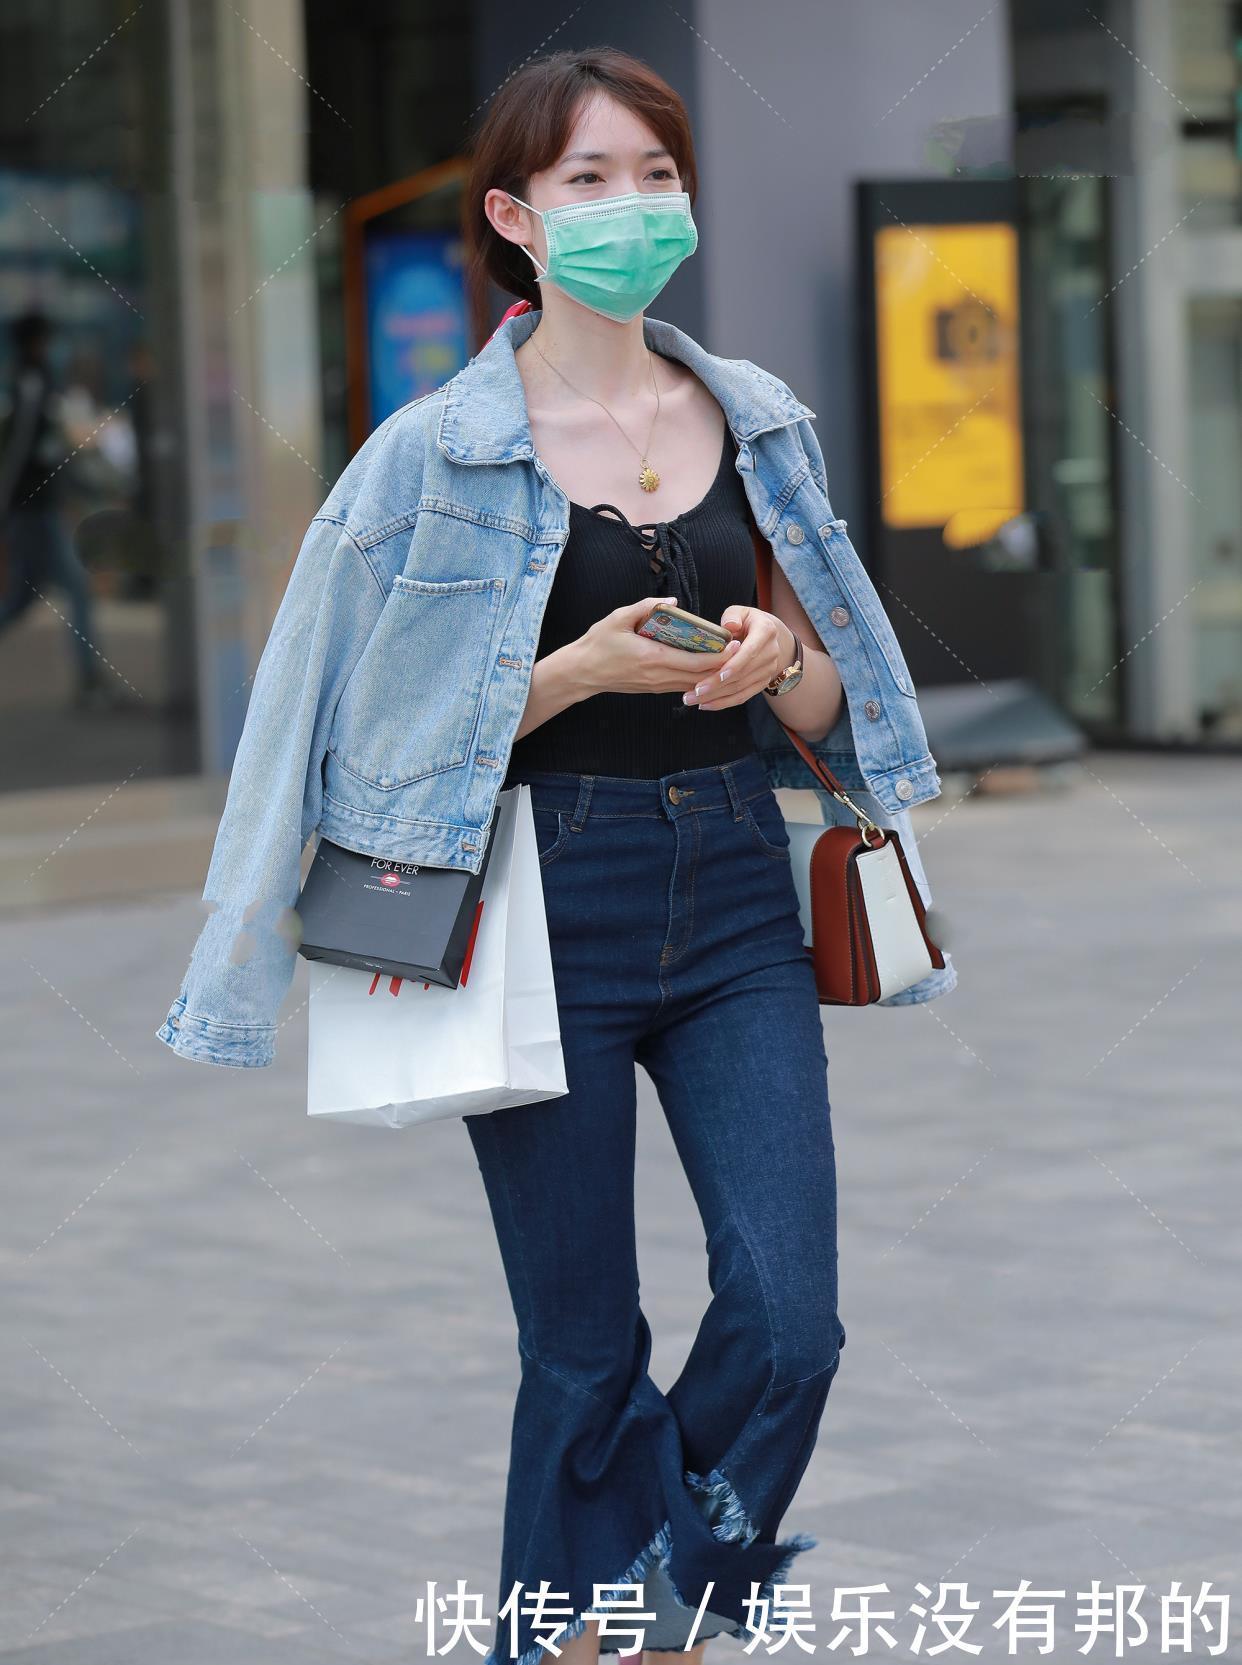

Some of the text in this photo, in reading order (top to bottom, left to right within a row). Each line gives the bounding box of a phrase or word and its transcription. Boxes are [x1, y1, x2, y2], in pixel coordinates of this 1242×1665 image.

[370, 858, 419, 875] FOR EVER
[363, 884, 395, 894] PROFESSIONAL
